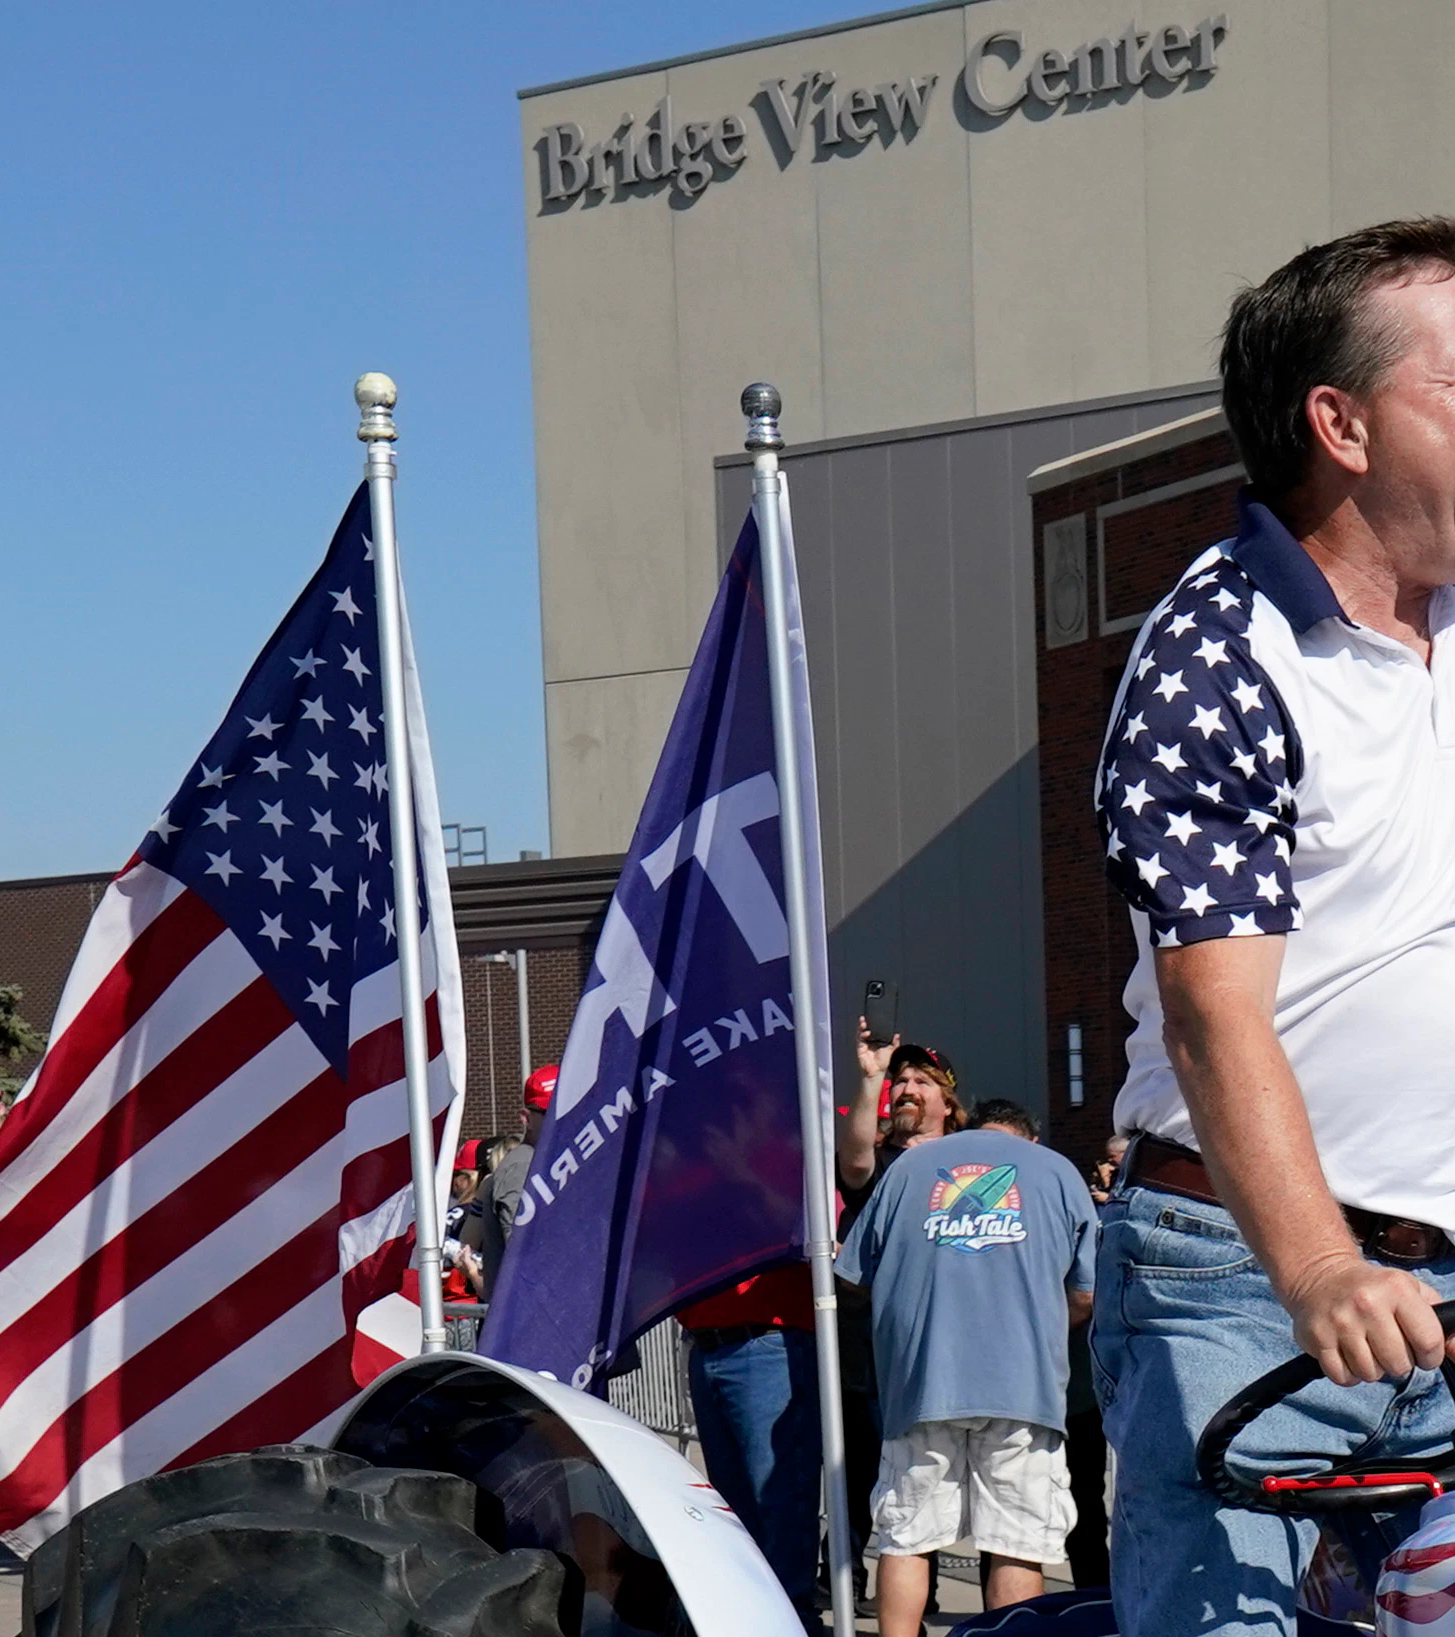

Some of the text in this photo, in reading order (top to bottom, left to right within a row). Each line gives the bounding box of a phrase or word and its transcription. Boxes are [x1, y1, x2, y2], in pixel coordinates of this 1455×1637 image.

[540, 13, 1230, 202] Bridge View Center
